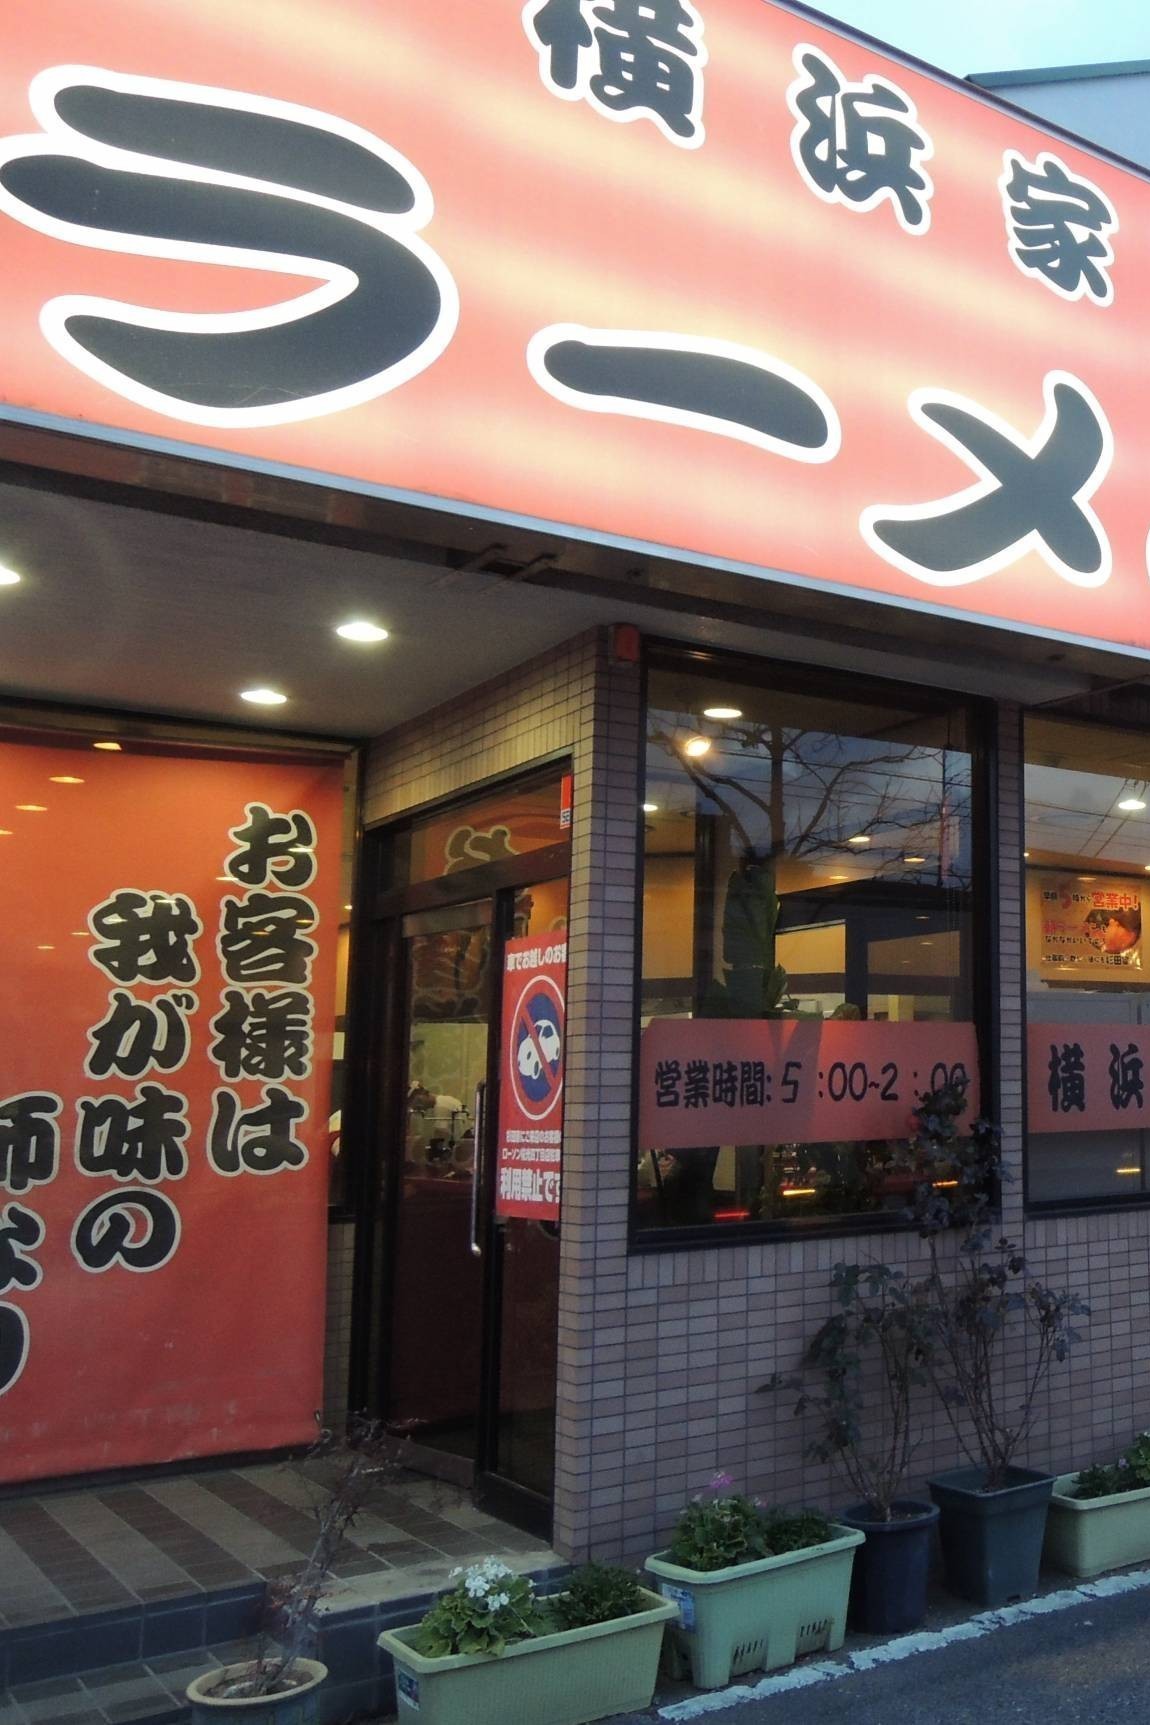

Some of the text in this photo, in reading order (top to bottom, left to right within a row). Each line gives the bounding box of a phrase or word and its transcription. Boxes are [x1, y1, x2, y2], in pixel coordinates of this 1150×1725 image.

[71, 887, 203, 1274] 我が味の
[209, 803, 318, 1177] お客様は
